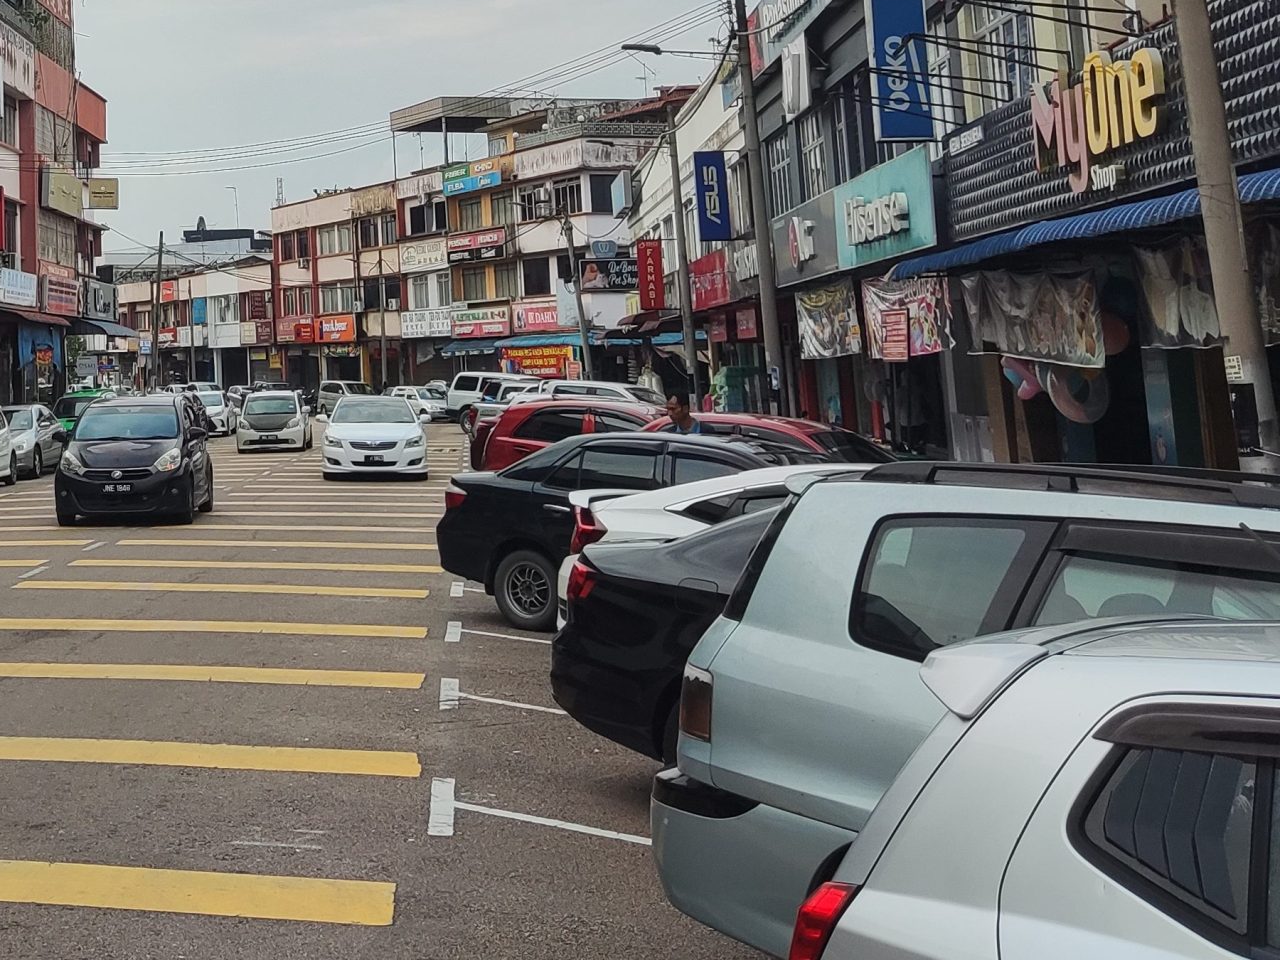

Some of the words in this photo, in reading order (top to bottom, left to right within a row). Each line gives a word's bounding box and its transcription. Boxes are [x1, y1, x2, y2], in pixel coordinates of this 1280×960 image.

[884, 36, 909, 113] beko
[1091, 163, 1118, 191] Shop
[844, 192, 909, 246] Hisense
[645, 248, 656, 307] FARMASI
